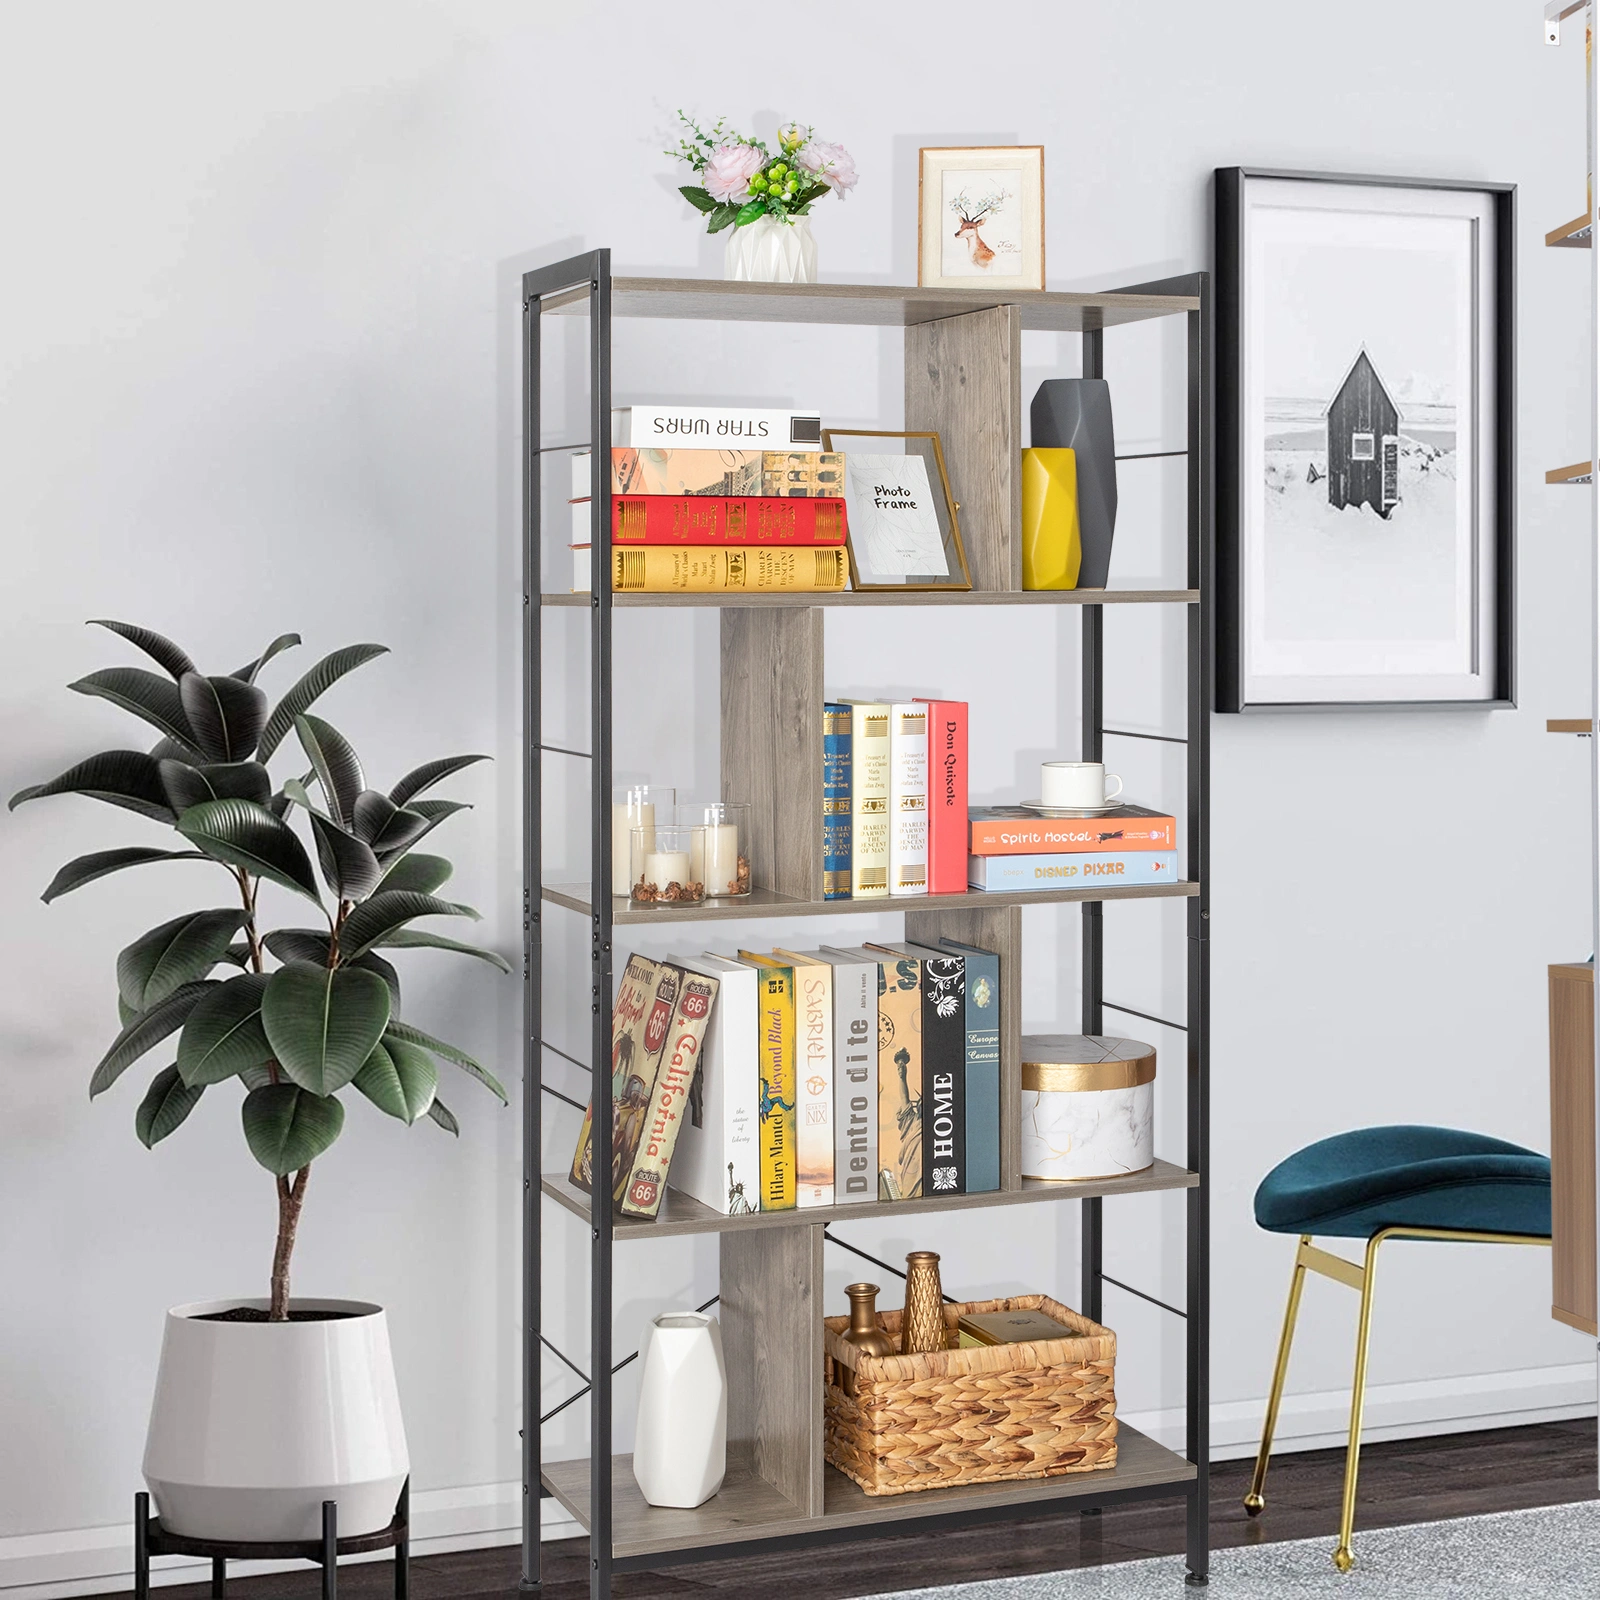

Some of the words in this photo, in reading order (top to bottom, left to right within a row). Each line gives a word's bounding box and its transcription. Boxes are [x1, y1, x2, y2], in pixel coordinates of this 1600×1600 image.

[653, 417, 709, 435] WARS
[717, 419, 769, 437] STAR
[874, 485, 911, 496] Photo
[874, 498, 917, 510] Frame
[672, 560, 681, 581] Treasury
[788, 575, 794, 584] OF
[946, 721, 957, 750] Don
[944, 754, 957, 806] Quixote
[1000, 832, 1041, 845] Spirit
[1044, 832, 1092, 842] Hostel
[1083, 862, 1125, 876] PIXAR
[626, 964, 654, 985] WELCOME
[658, 982, 674, 1000] ROUTE
[690, 984, 709, 995] ROUTE
[687, 998, 703, 1013] 66
[650, 1010, 665, 1040] 66
[768, 1008, 782, 1044] Black
[847, 1019, 868, 1046] te
[968, 1034, 999, 1044] Europe
[968, 1050, 999, 1060] Canvas
[768, 1047, 787, 1095] Beyond
[846, 1055, 868, 1083] di
[646, 1034, 697, 1157] California
[808, 1110, 825, 1123] NIX
[934, 1072, 953, 1159] HOME
[768, 1114, 784, 1158] Mantel
[846, 1096, 868, 1194] Dentro
[638, 1172, 658, 1182] ROUTE
[770, 1160, 788, 1201] Hilary
[636, 1185, 652, 1200] 66
